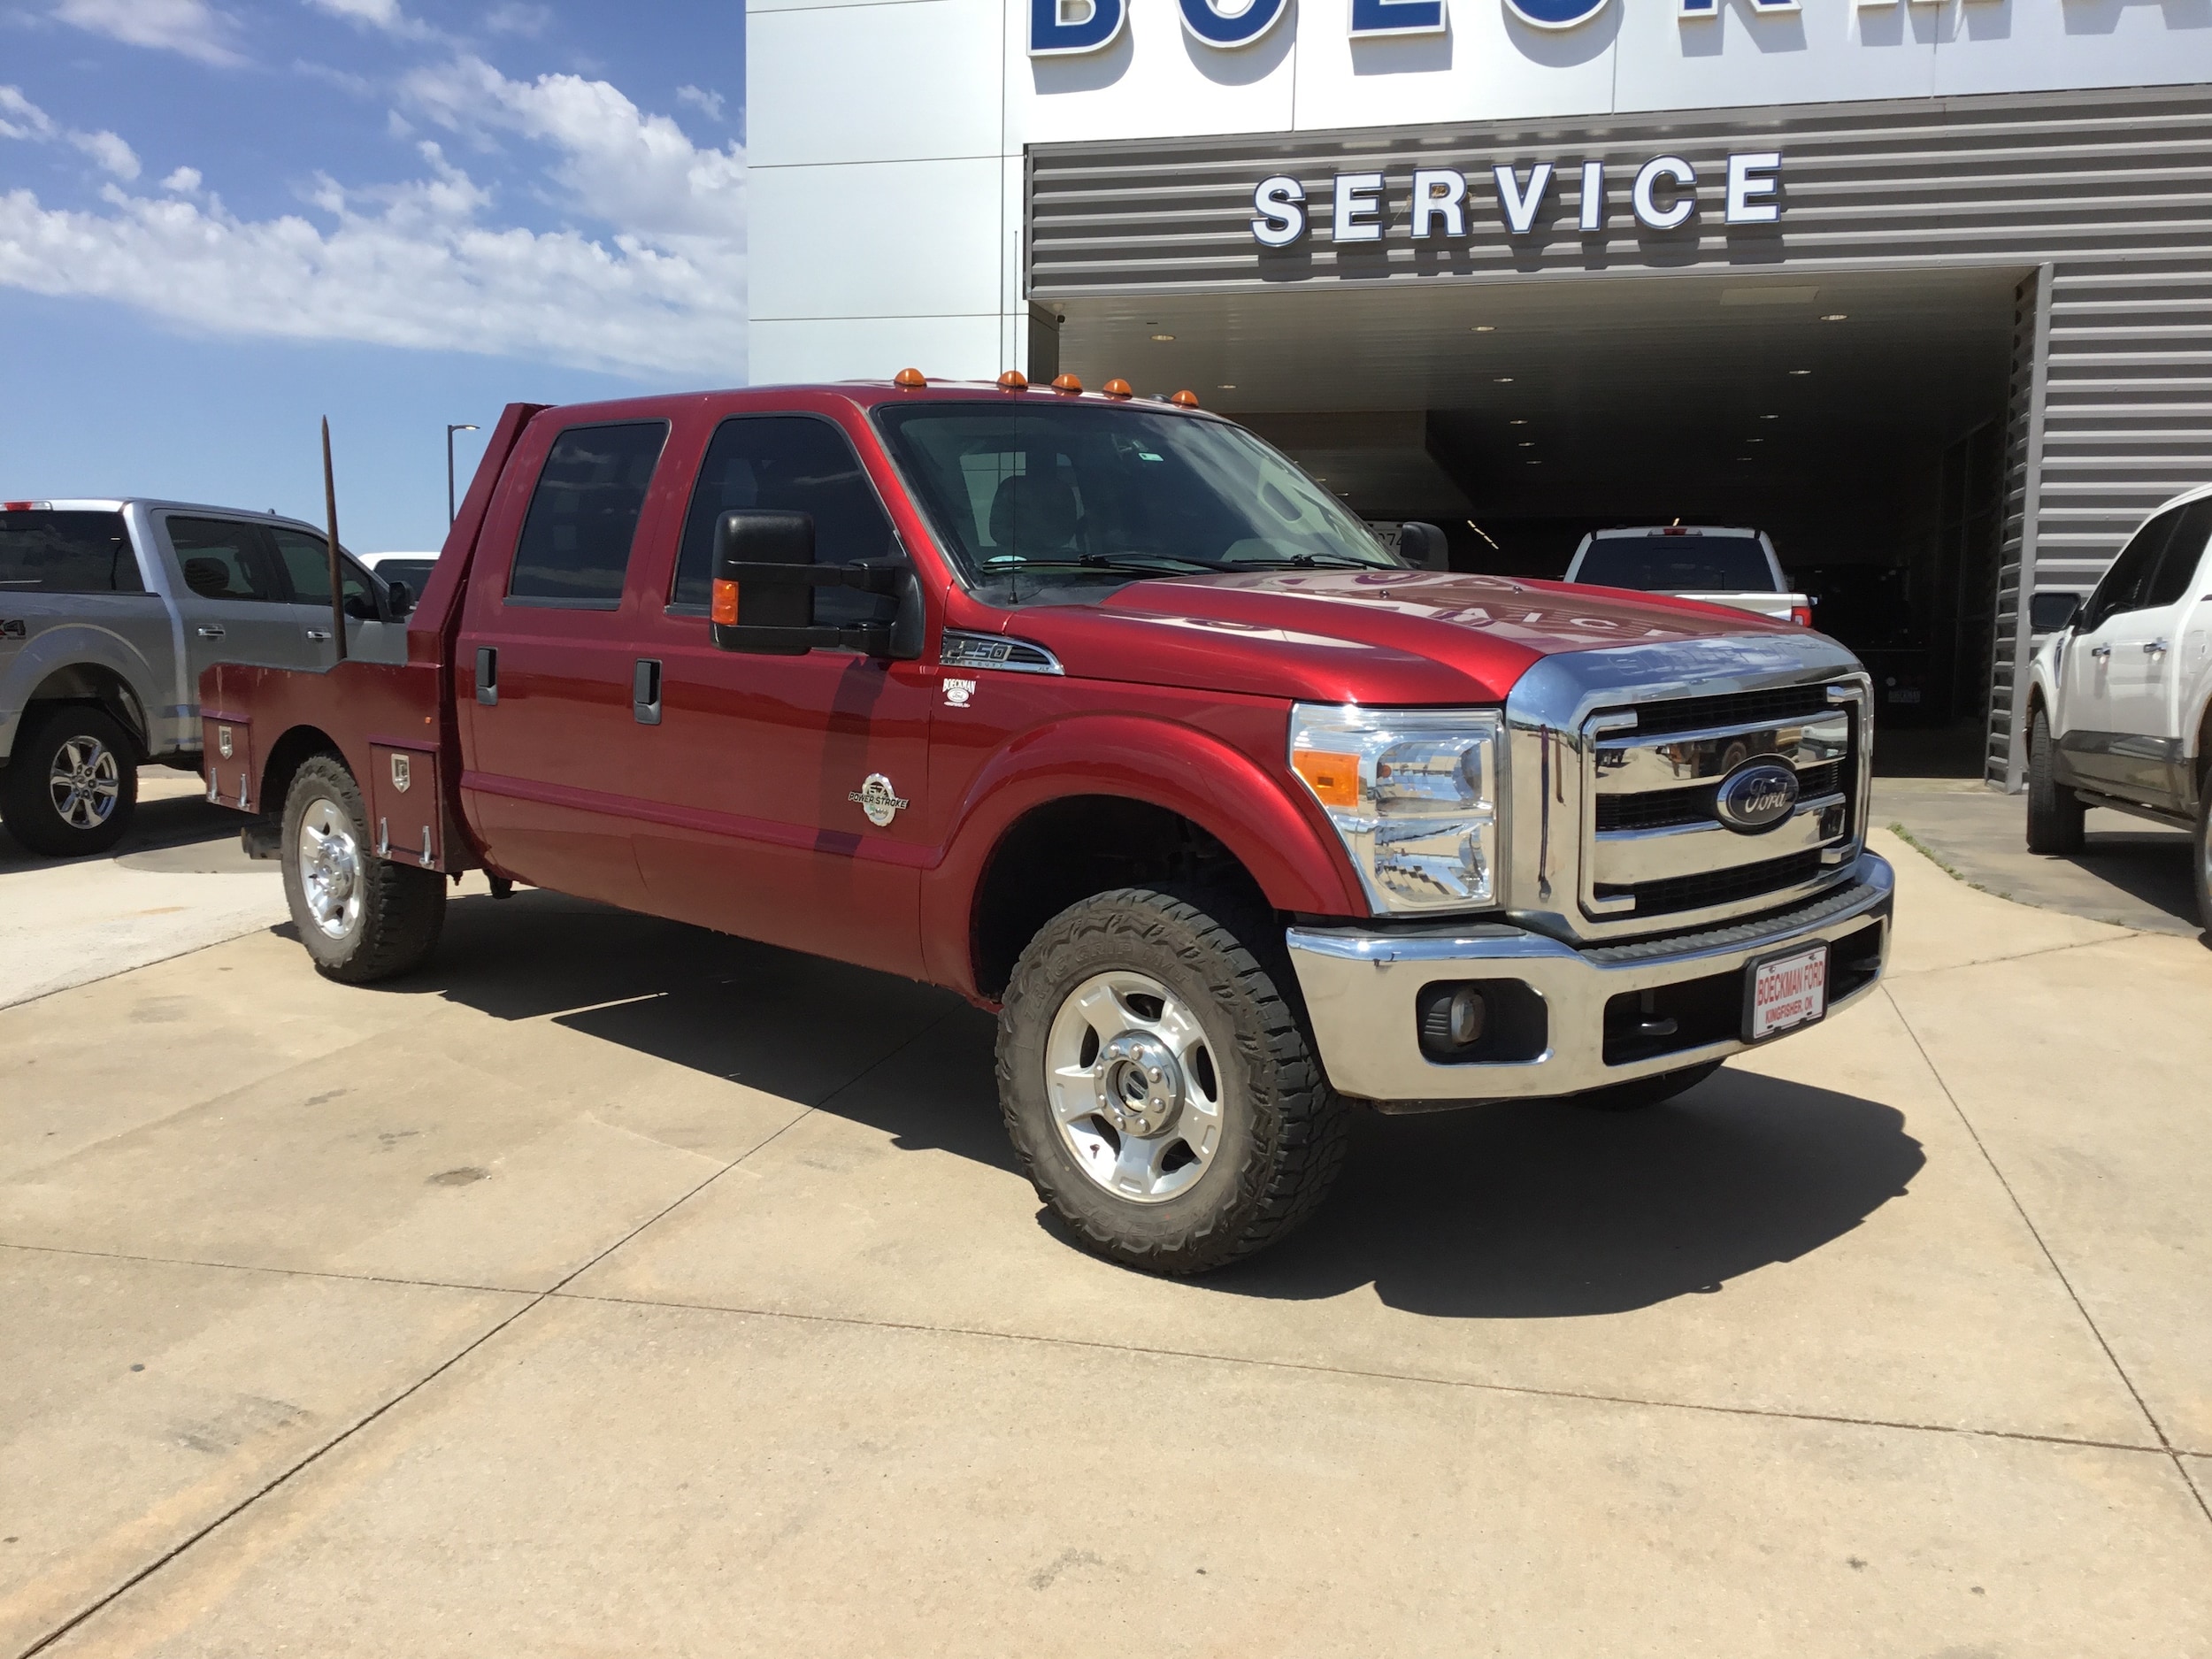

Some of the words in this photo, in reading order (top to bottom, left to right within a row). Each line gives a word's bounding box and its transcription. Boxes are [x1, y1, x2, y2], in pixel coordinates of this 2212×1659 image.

[1249, 151, 1783, 248] SERVICE
[942, 678, 977, 695] BOECKMAN
[849, 793, 874, 803] POWER
[875, 796, 907, 808] STROKE
[1745, 778, 1787, 813] Ford
[1075, 941, 1134, 963] GRIP
[1757, 966, 1802, 1006] BOECKMAN
[1803, 960, 1824, 990] FORD
[1805, 995, 1813, 1011] OK
